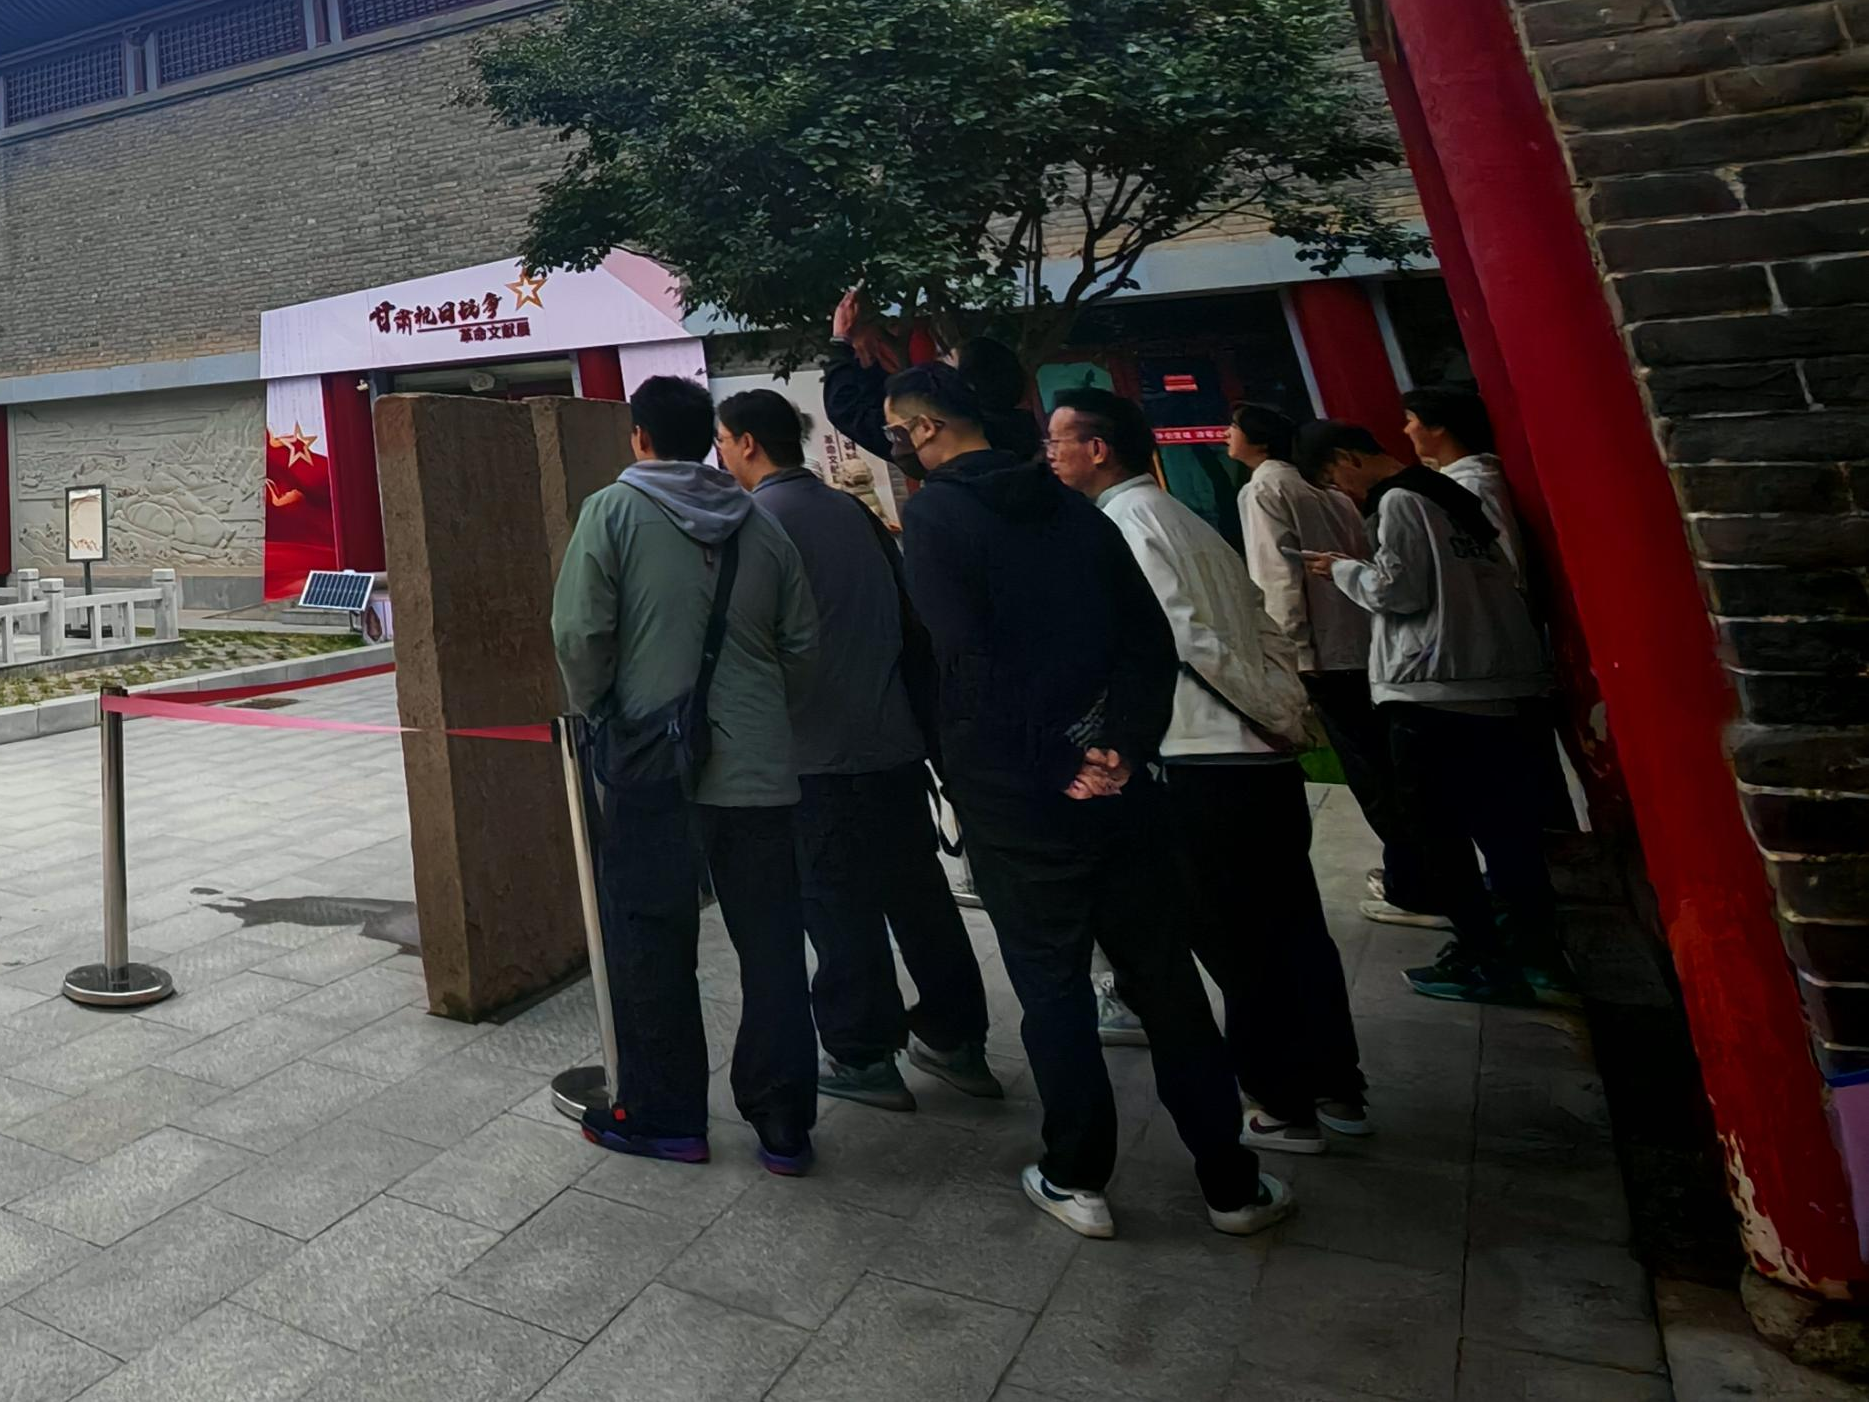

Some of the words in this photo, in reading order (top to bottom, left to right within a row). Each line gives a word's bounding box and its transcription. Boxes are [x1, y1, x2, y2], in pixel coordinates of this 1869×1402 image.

[369, 292, 503, 336] 甘肃抗日战争
[459, 321, 531, 343] 革命文献展
